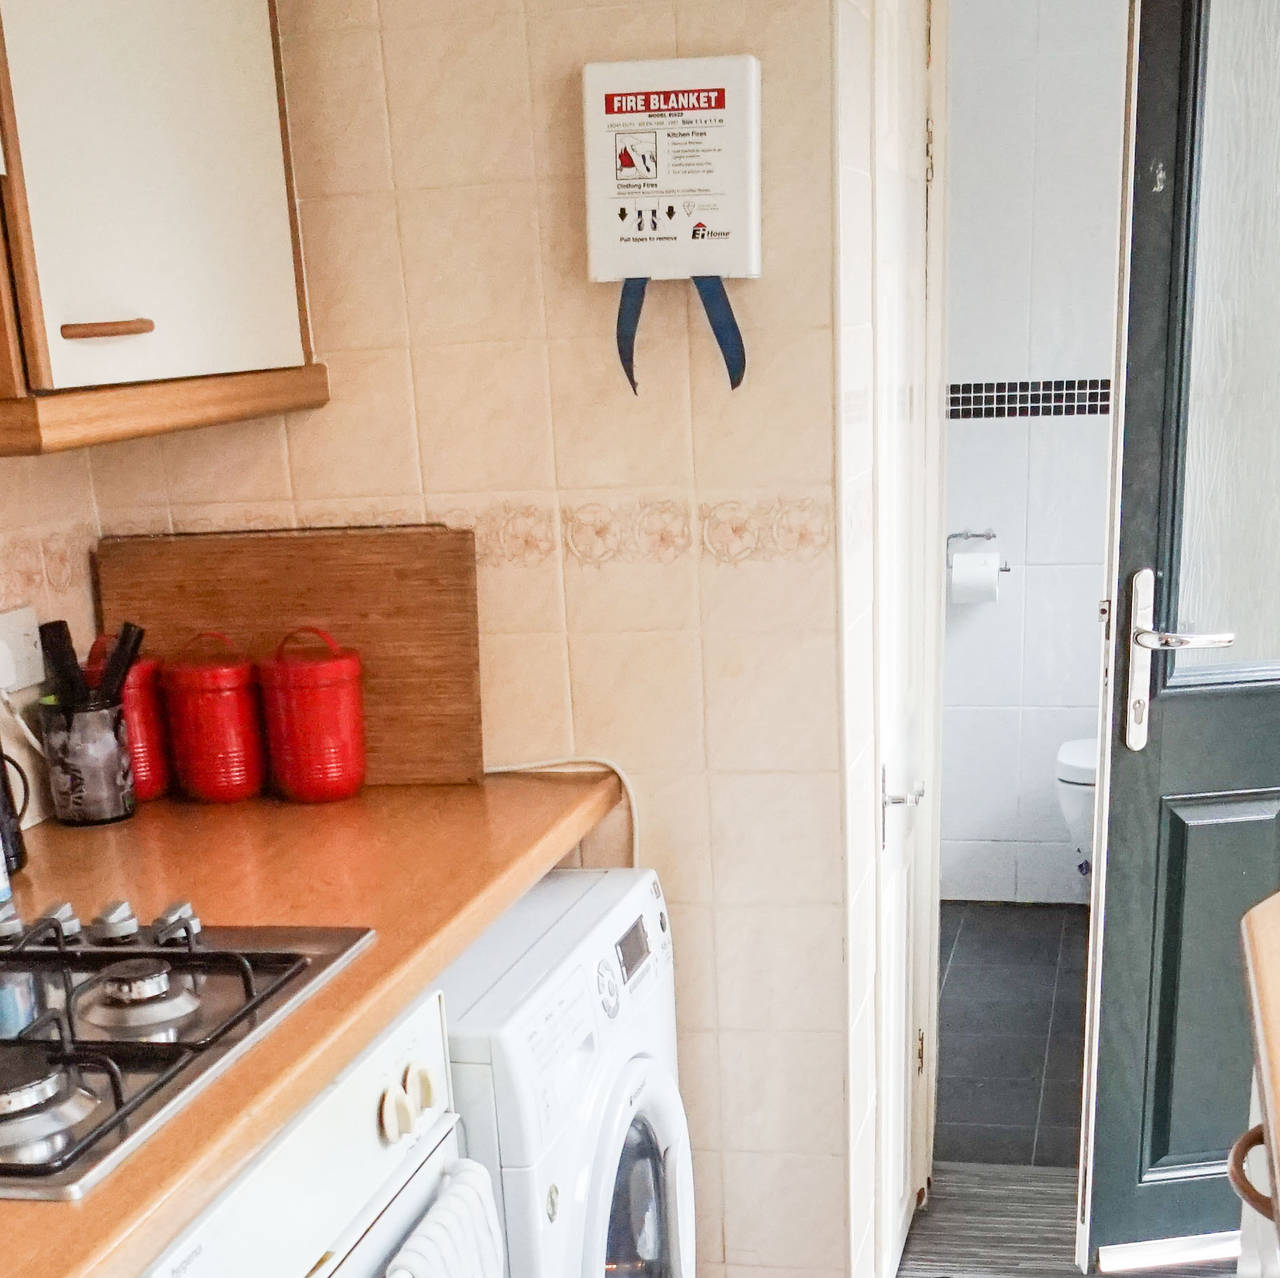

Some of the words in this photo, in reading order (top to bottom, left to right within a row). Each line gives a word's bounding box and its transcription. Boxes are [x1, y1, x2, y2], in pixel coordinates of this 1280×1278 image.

[613, 95, 646, 112] FIRE
[649, 91, 718, 110] BLANKET
[692, 229, 706, 240] Ei
[707, 230, 730, 239] Home
